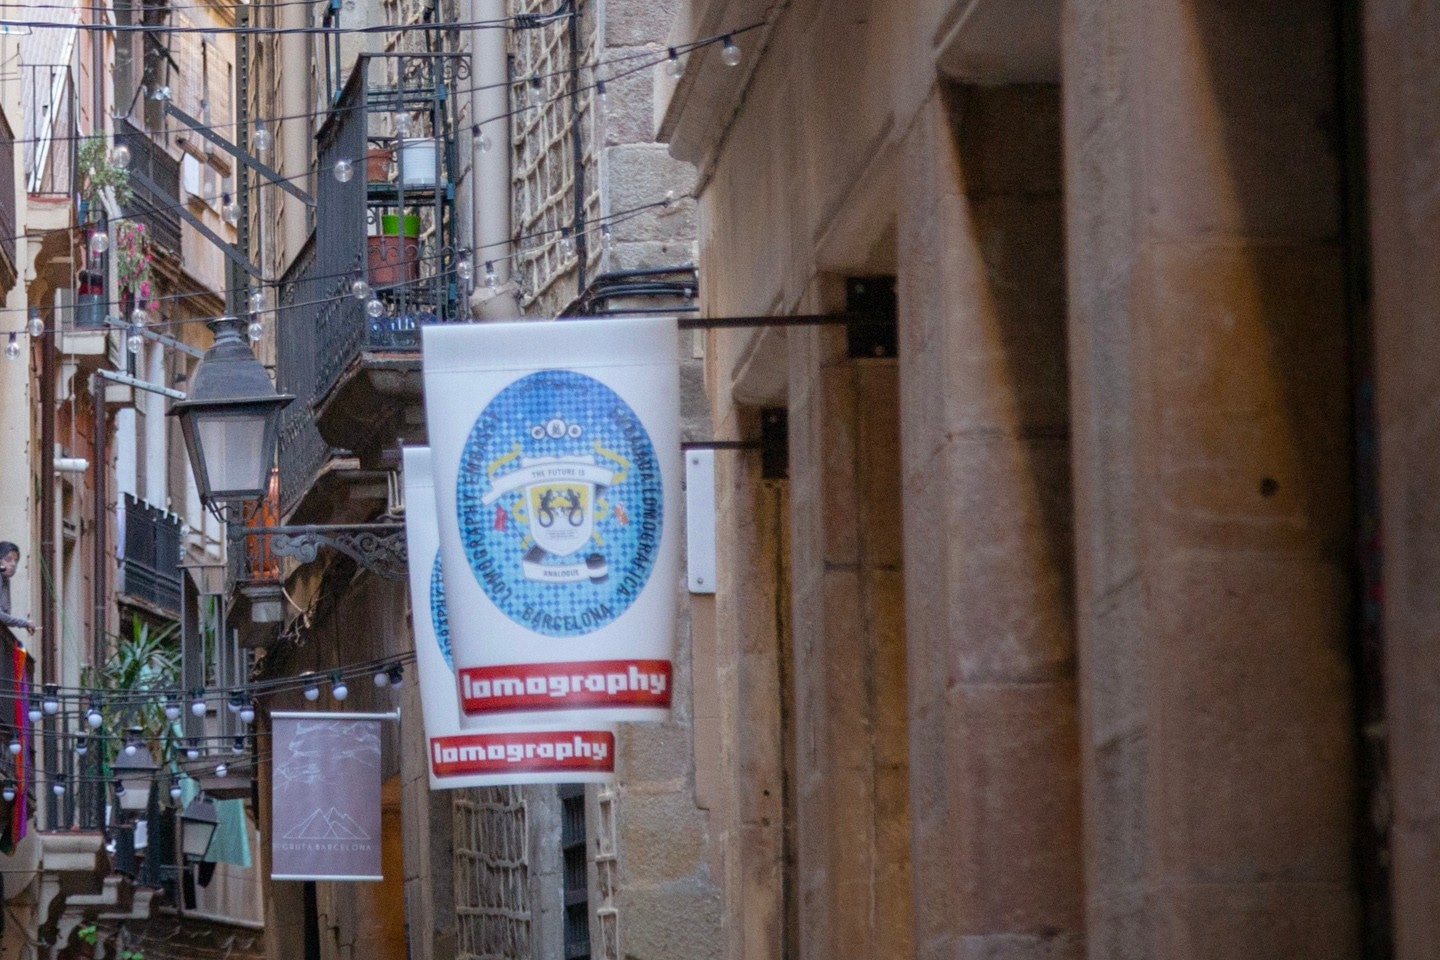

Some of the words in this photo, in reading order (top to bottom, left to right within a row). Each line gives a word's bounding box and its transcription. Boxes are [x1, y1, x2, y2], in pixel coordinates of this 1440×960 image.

[531, 471, 546, 479] THE
[548, 469, 575, 477] FUTURE
[578, 468, 586, 476] IS
[462, 493, 513, 604] LOMOGRAPHY
[543, 569, 580, 578] ANALOGUE
[521, 604, 613, 632] BARCELONA
[462, 665, 667, 699] lomography
[433, 736, 608, 763] lomography
[315, 843, 371, 851] BARCELONA
